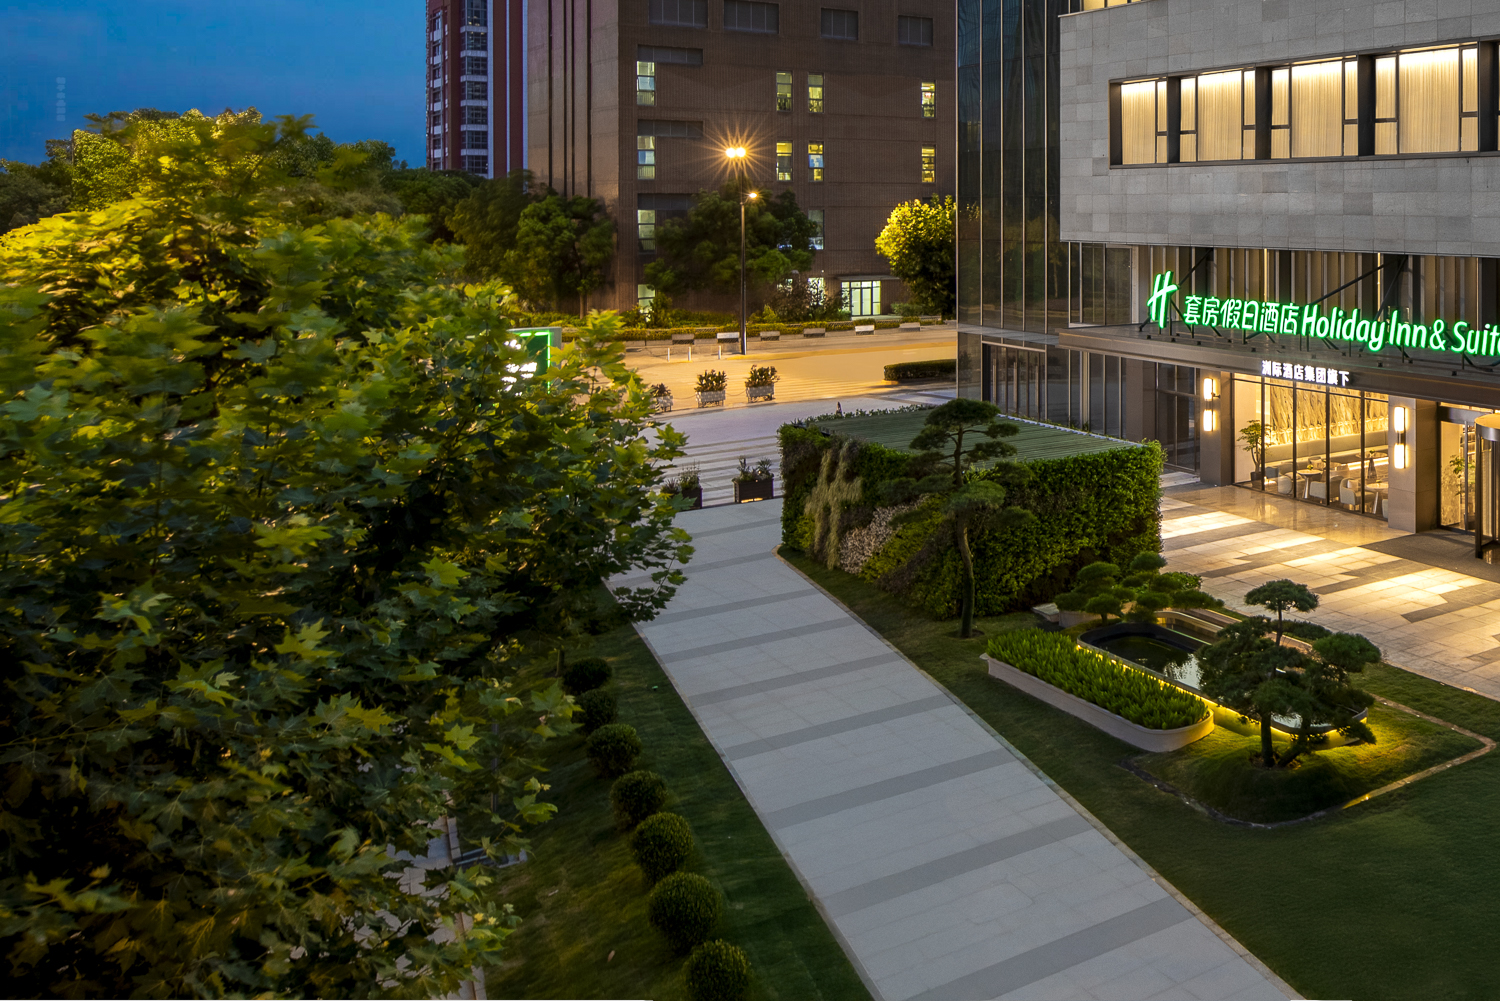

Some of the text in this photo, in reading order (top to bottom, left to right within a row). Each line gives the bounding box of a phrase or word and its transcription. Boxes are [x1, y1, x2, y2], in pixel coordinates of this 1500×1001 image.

[1183, 294, 1300, 336] 套房假日酒店
[1300, 303, 1386, 352] Holiday
[1388, 309, 1428, 349] Inn
[1261, 359, 1350, 387] 洲际酒店集团旗下
